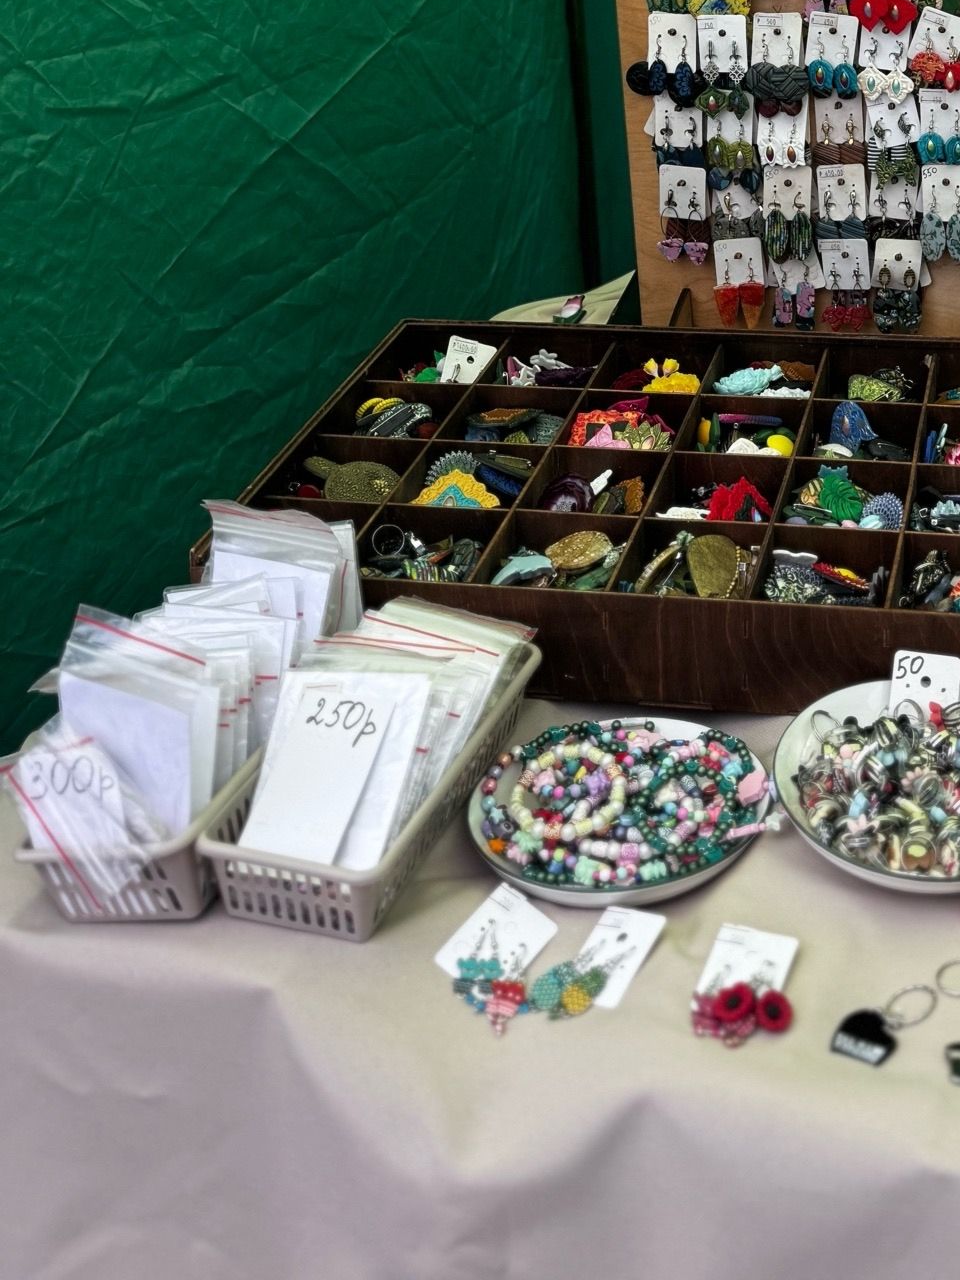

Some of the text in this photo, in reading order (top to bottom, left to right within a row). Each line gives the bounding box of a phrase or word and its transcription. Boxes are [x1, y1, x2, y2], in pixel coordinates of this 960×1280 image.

[922, 166, 938, 179] 550
[896, 655, 925, 679] 50
[306, 697, 377, 748] 250р
[29, 755, 115, 801] 300р
